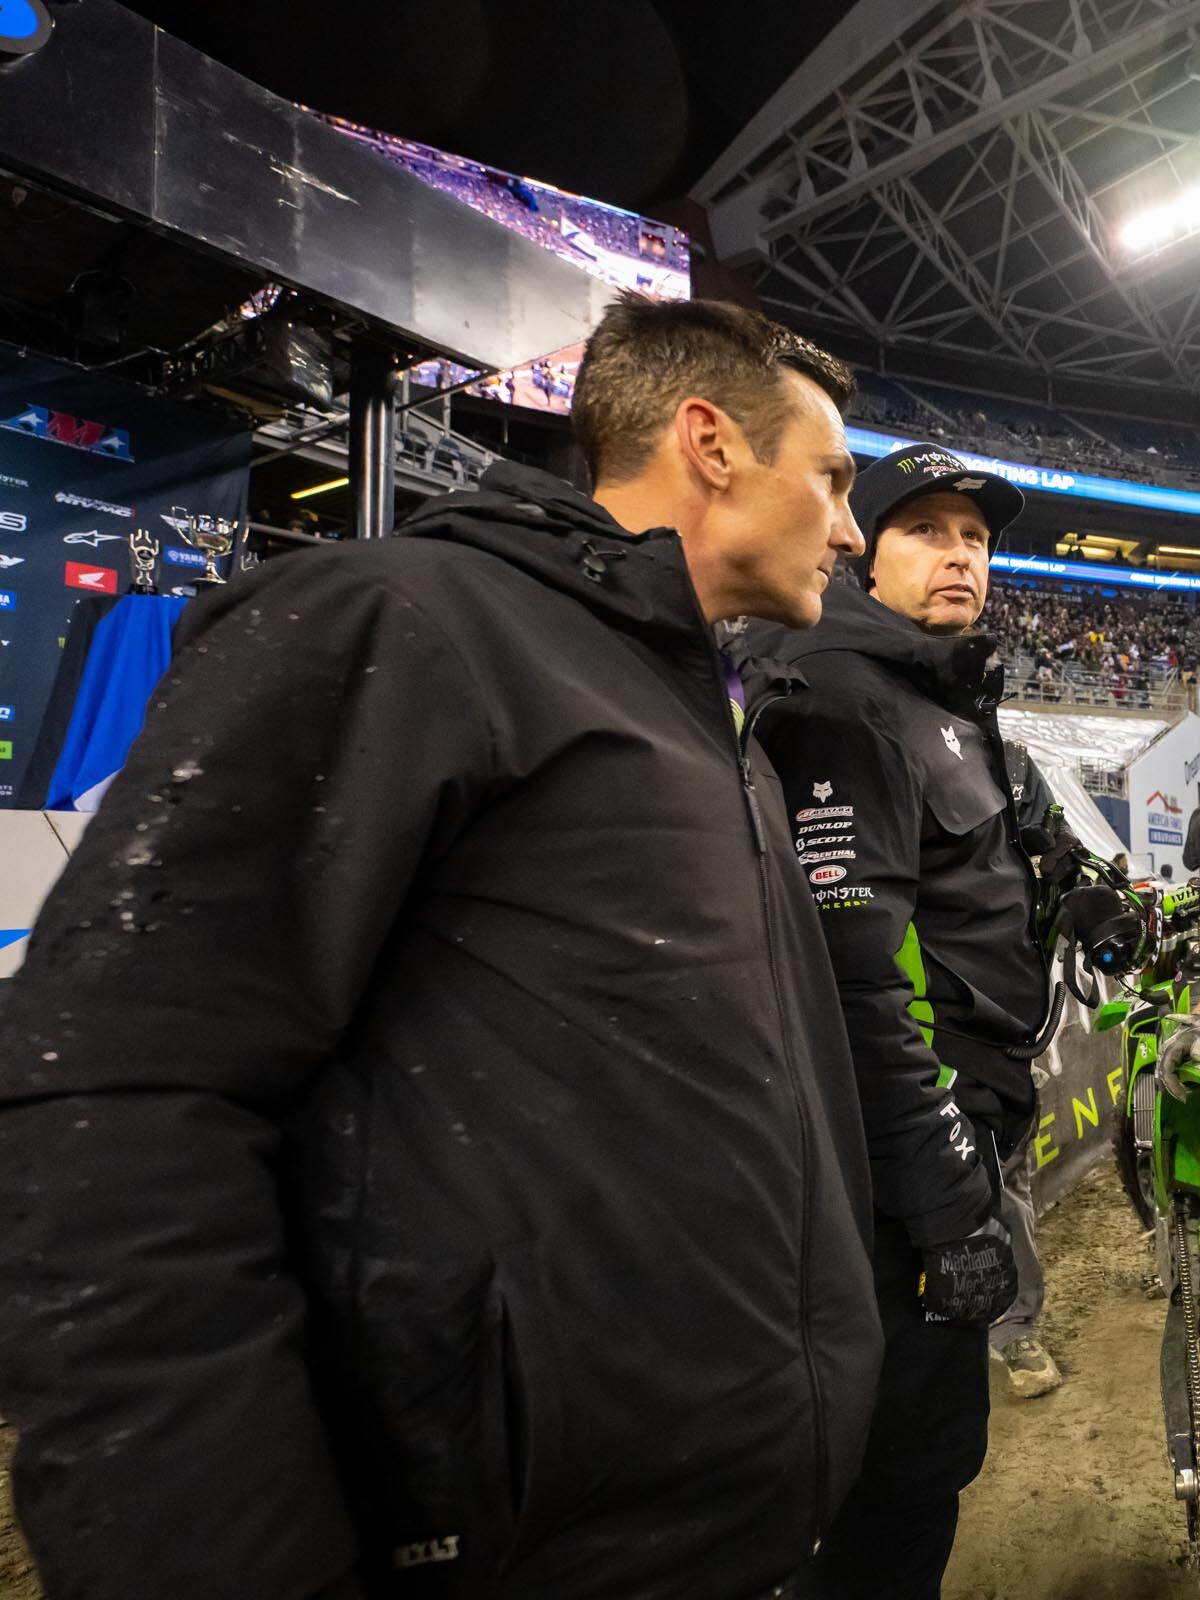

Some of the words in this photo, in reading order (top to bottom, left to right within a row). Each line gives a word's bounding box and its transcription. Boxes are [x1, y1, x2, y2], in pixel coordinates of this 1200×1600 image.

[1041, 472, 1076, 490] LAP
[798, 821, 852, 834] DUNLOP
[806, 835, 856, 847] SCOTT
[815, 870, 840, 880] BELL
[813, 887, 875, 903] ONSTER
[940, 1101, 976, 1161] FOX
